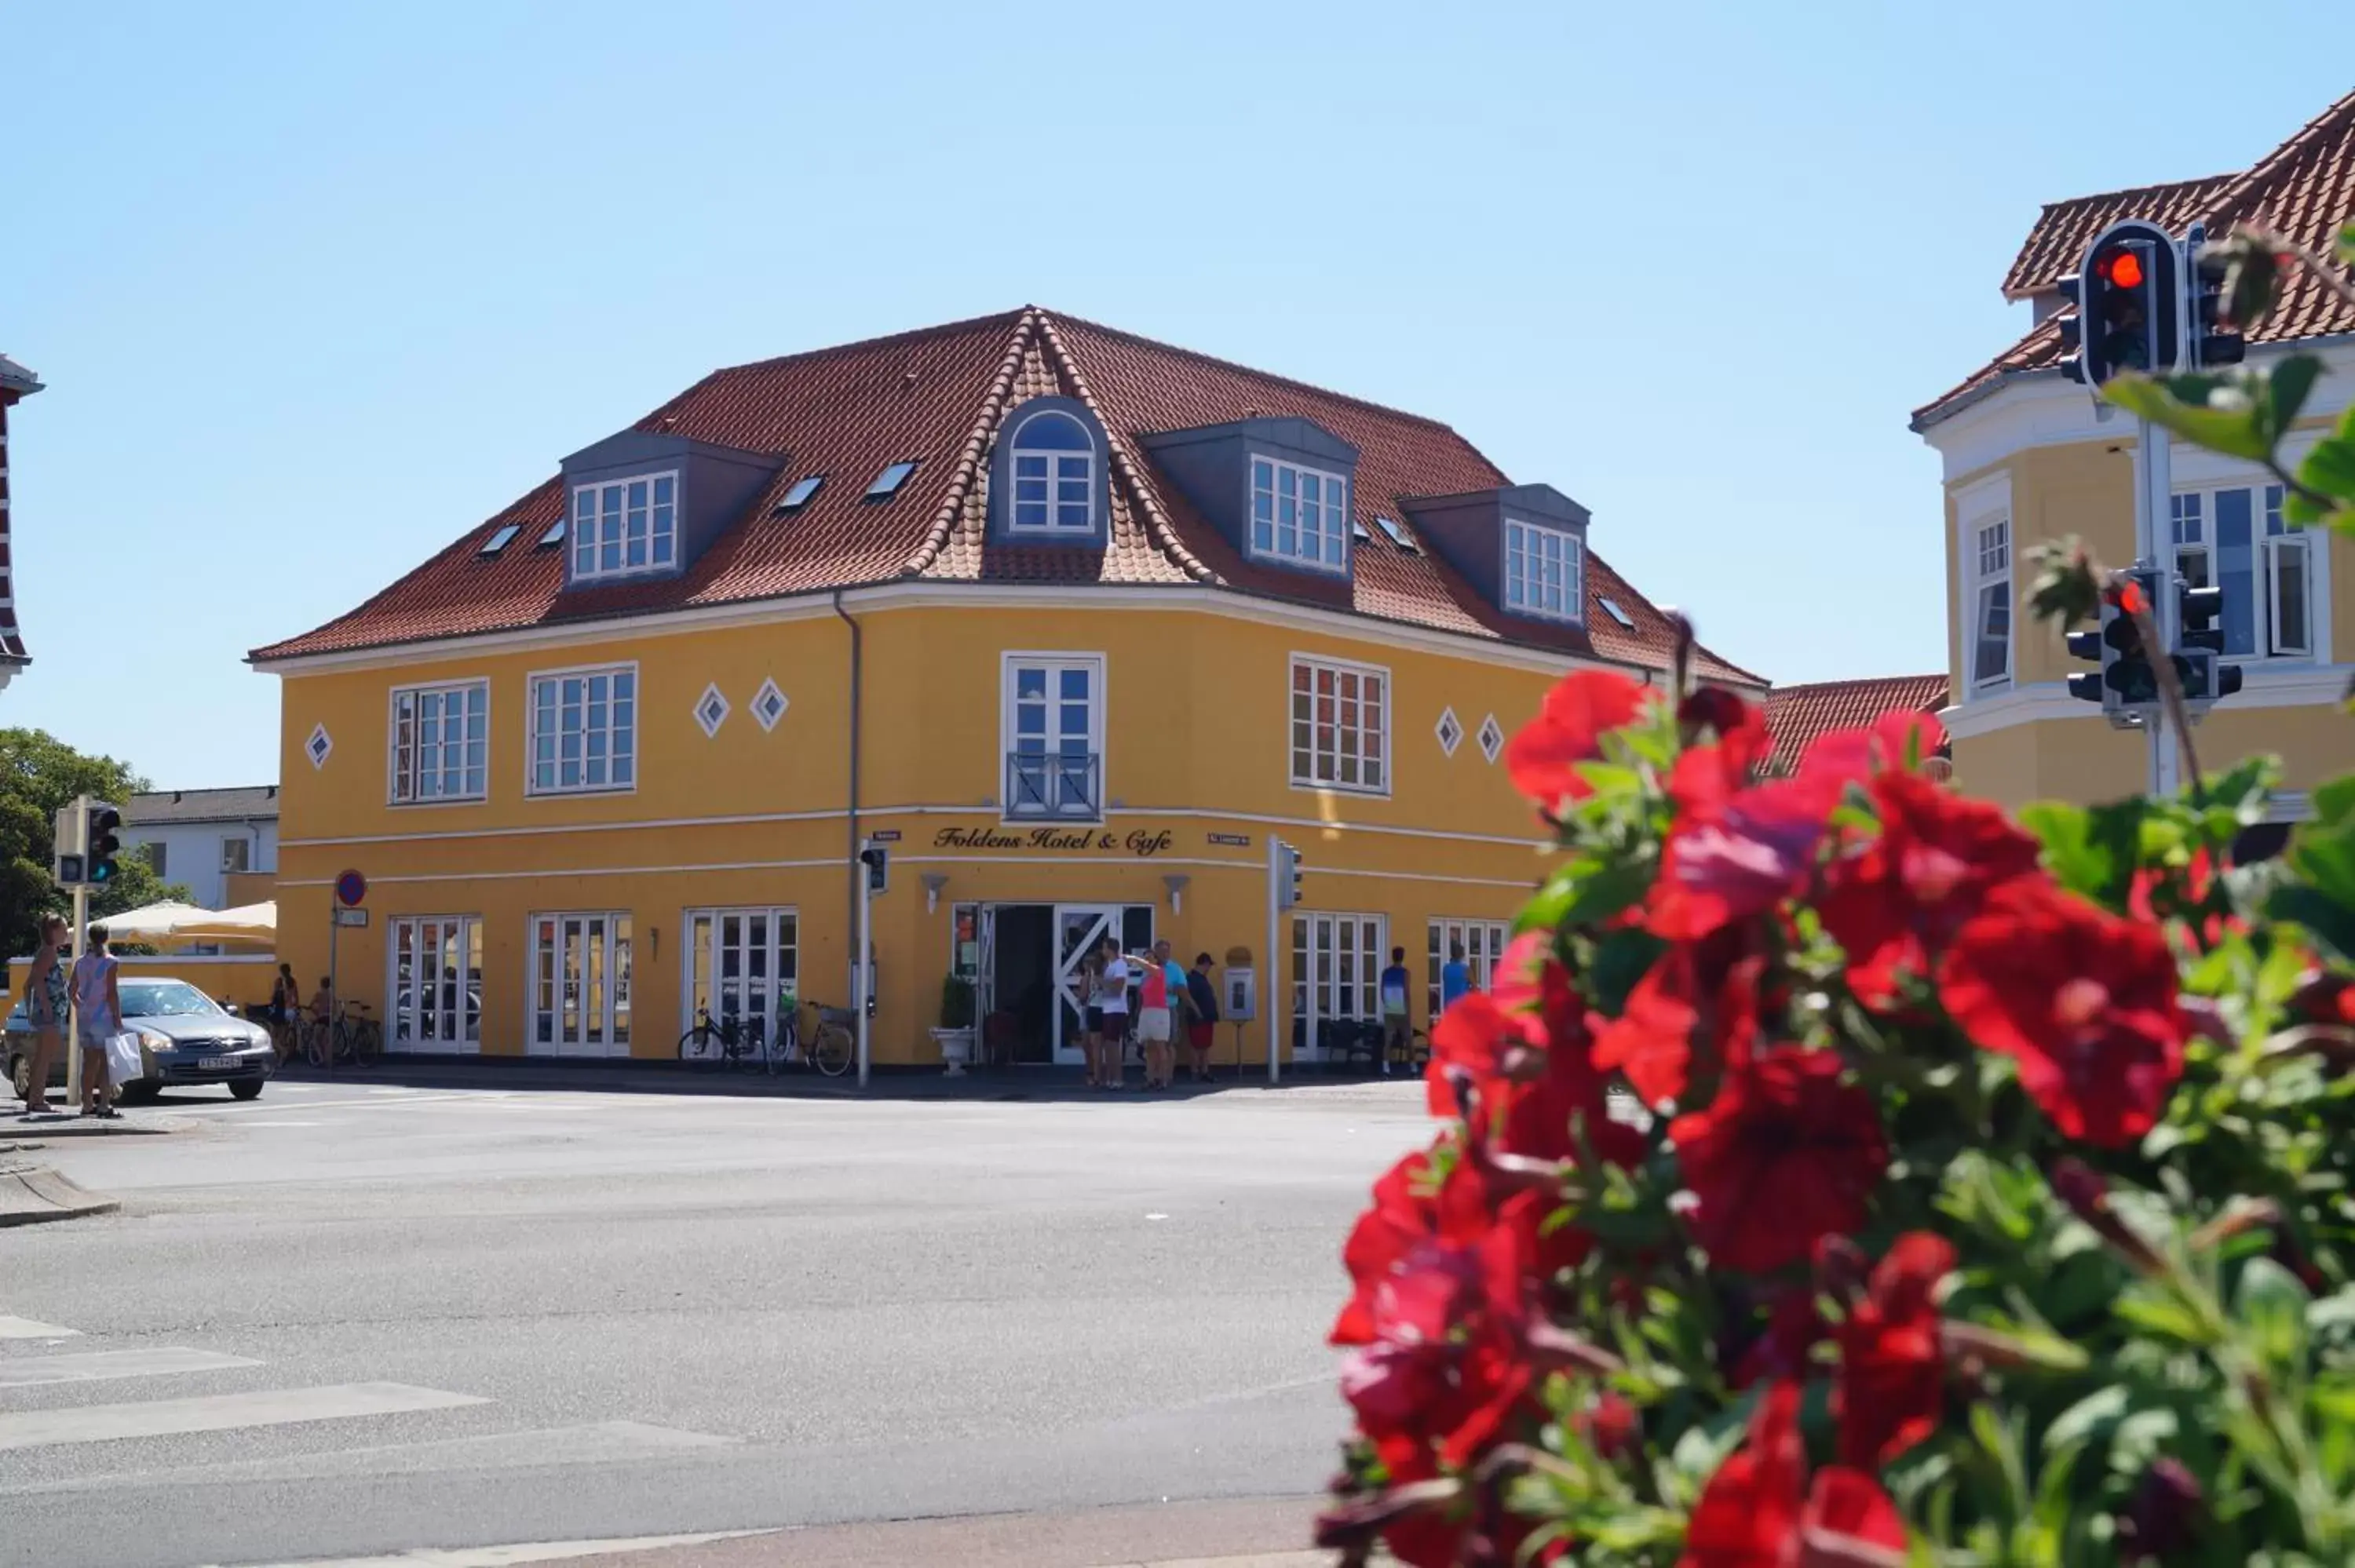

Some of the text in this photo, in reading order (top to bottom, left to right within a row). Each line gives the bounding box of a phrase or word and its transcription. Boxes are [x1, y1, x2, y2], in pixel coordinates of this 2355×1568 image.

[933, 828, 1172, 856] Foldens Hotel & Cafe
